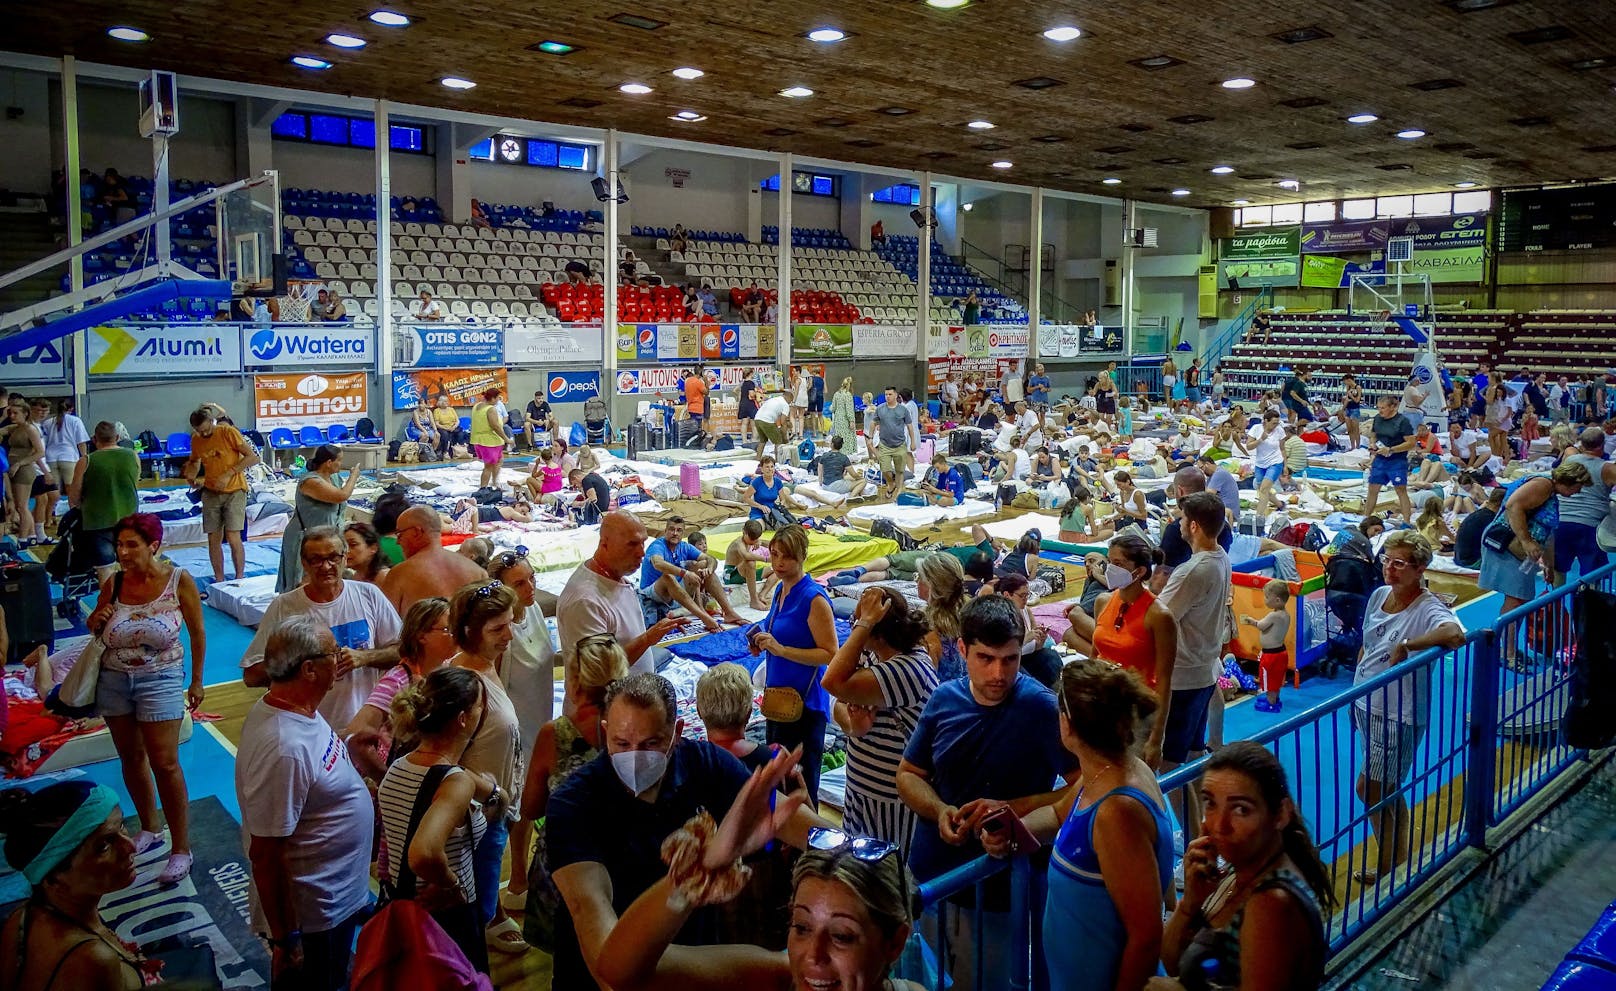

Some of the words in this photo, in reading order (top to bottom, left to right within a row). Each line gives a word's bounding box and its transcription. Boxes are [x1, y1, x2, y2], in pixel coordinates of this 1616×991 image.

[284, 335, 365, 354] Watera
[425, 332, 457, 344] OTIS
[135, 337, 223, 357] Alumil
[1086, 400, 1095, 408] 10
